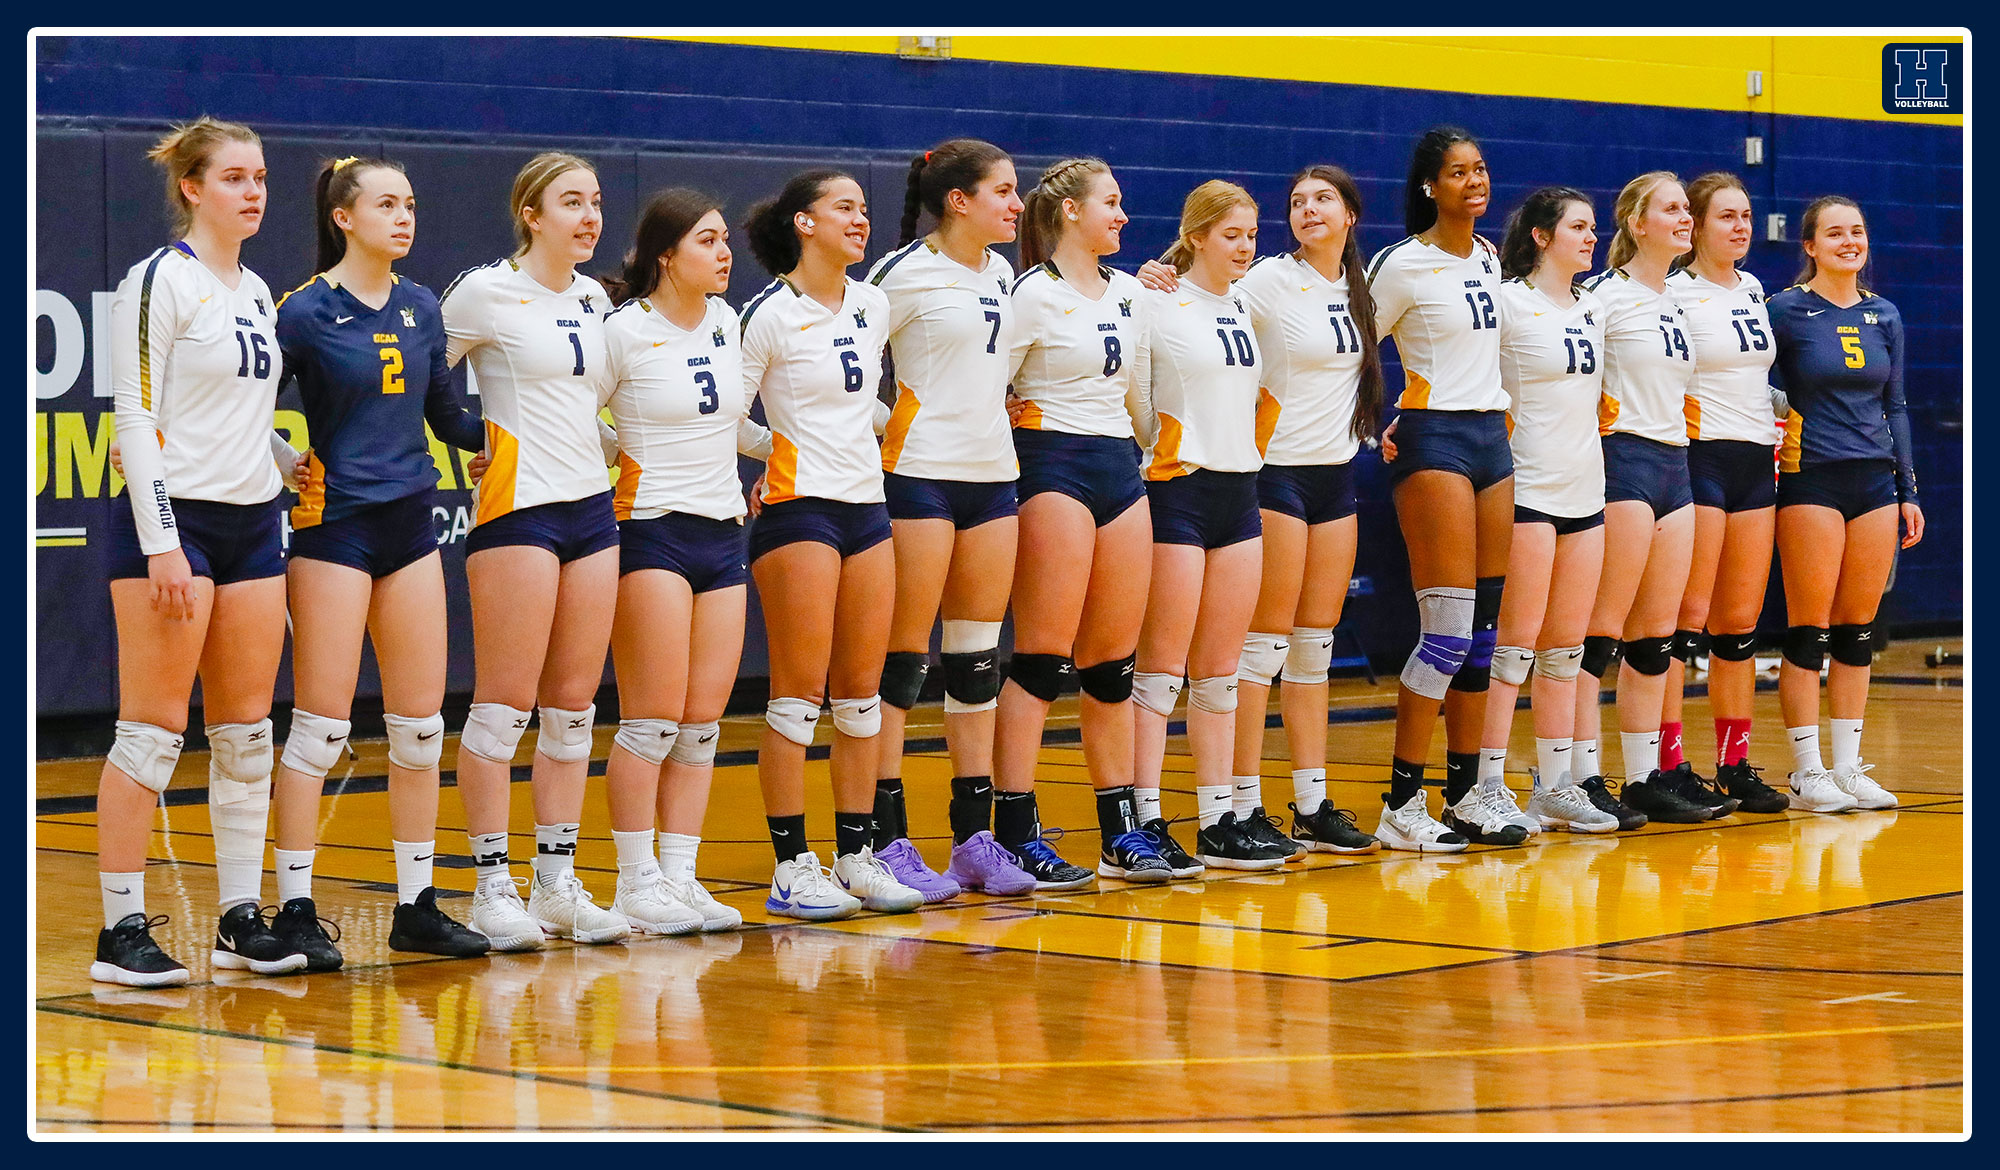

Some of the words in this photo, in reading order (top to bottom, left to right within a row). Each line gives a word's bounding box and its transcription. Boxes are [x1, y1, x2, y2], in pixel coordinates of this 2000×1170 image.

[1463, 280, 1482, 289] OCAA
[979, 297, 1000, 307] OCAA
[1327, 303, 1345, 312] OCAA
[1465, 291, 1497, 331] 12
[1731, 308, 1751, 316] OCAA
[235, 316, 255, 328] OCAA
[372, 333, 399, 344] OCAA
[556, 319, 581, 328] OCAA
[983, 310, 1001, 355] 7
[1097, 323, 1118, 332] OCAA
[1216, 317, 1238, 326] OCAA
[1329, 315, 1360, 354] 11
[1565, 327, 1583, 335] OCAA
[1731, 319, 1769, 353] 15
[1836, 325, 1860, 334] OCAA
[236, 330, 271, 380] 16
[568, 332, 586, 377] 1
[833, 336, 855, 347] OCAA
[1102, 335, 1122, 378] 8
[1216, 328, 1255, 368] 10
[1563, 337, 1596, 375] 13
[1659, 325, 1690, 362] 14
[1840, 335, 1866, 369] 5
[378, 346, 406, 395] 2
[687, 356, 711, 367] OCAA
[839, 350, 864, 393] 6
[693, 370, 720, 416] 3
[152, 479, 175, 530] HUMBER
